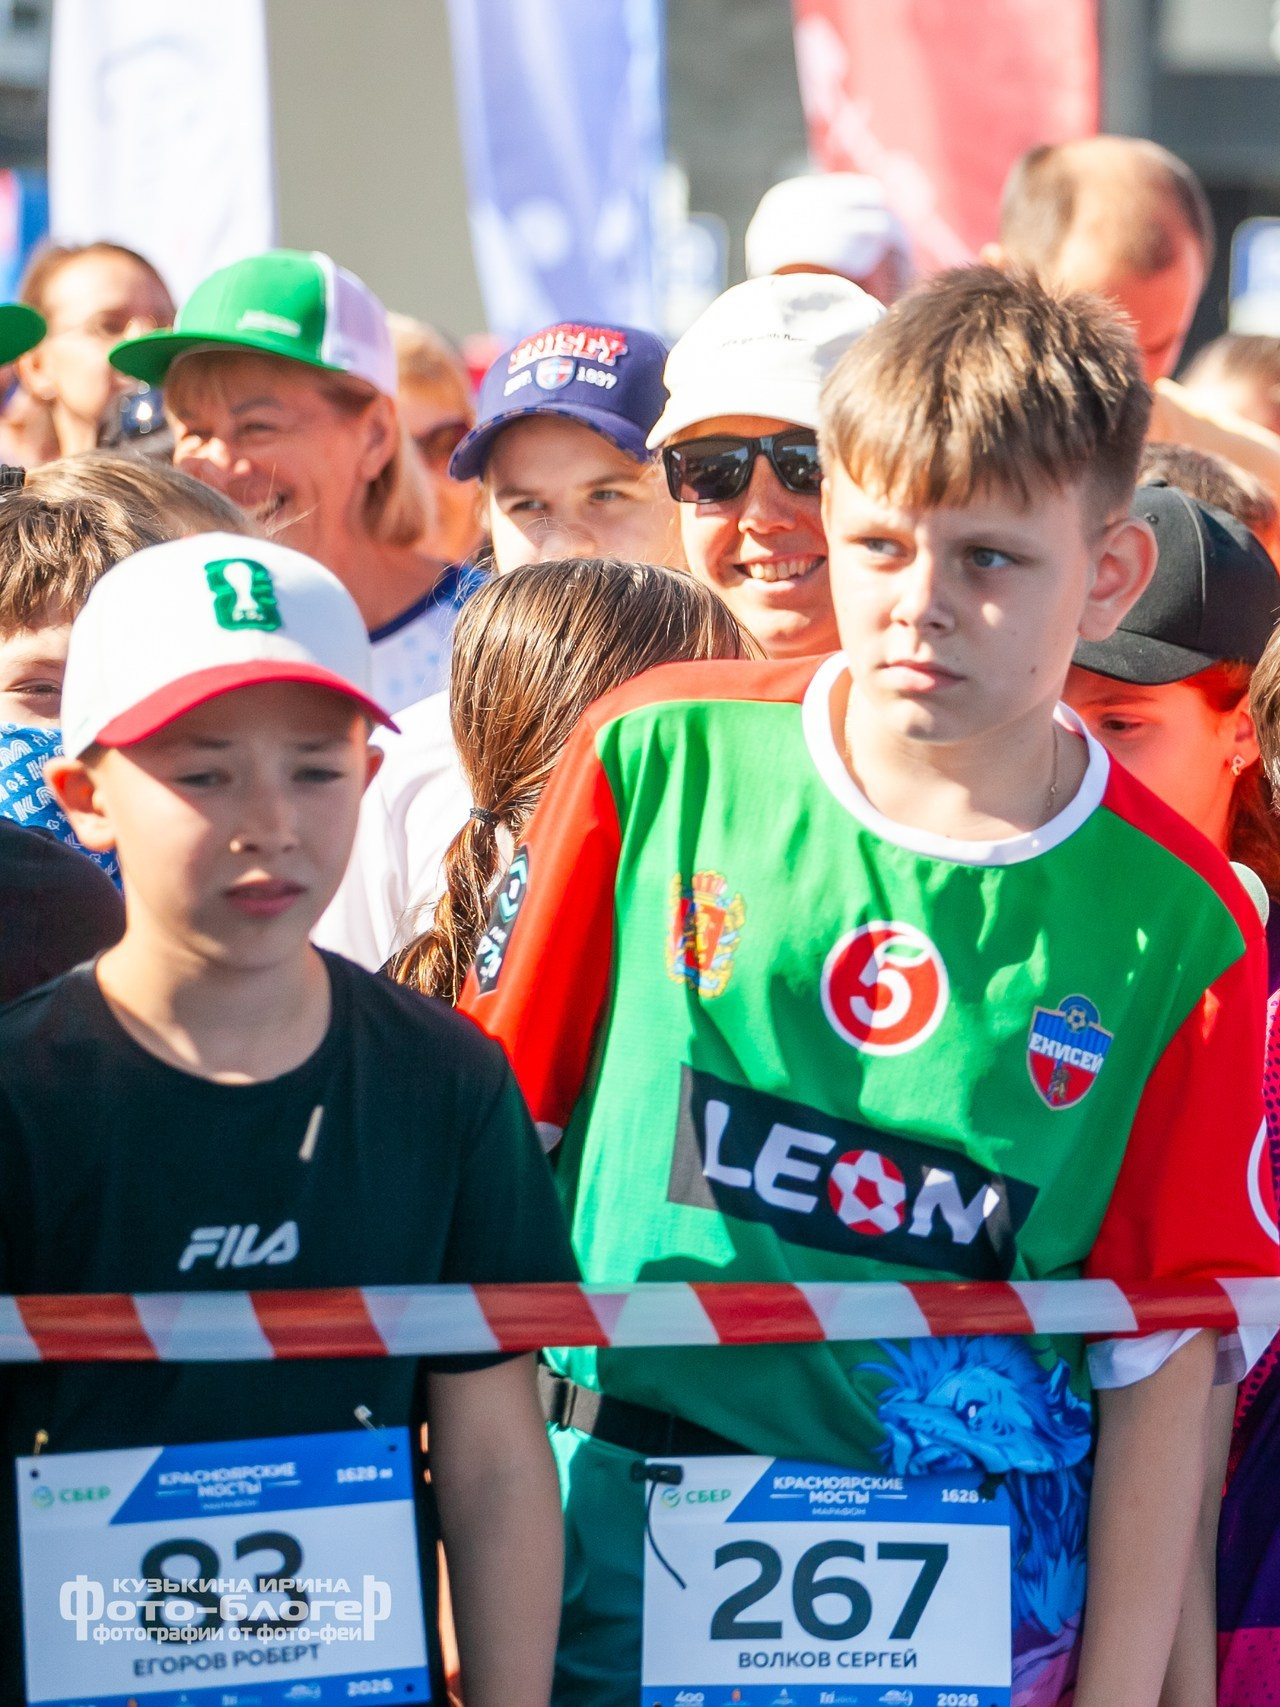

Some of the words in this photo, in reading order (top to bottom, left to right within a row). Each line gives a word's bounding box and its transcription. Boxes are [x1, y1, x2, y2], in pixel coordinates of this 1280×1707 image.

[1028, 1031, 1105, 1074] ЕНИСЕЙ
[702, 1099, 1000, 1246] LEON
[178, 1220, 300, 1272] FILA
[159, 1461, 297, 1486] КРАСНОЯРСКИЕ
[773, 1475, 904, 1491] КРАСНОЯРСКИЕ
[58, 1485, 111, 1505] СБЕР
[197, 1479, 262, 1498] МОСТЫ
[685, 1488, 732, 1504] СБЕР
[809, 1490, 870, 1505] МОСТЫ
[941, 1488, 980, 1504] 1628
[140, 1529, 310, 1645] 83
[710, 1538, 950, 1642] 267
[133, 1651, 227, 1678] ЕГОРОВ
[232, 1643, 322, 1668] РОБЕРТ
[739, 1651, 831, 1669] ВОЛКОВ
[837, 1647, 918, 1669] СЕРГЕЙ
[347, 1677, 394, 1698] 2026
[937, 1692, 979, 1706] 2026
